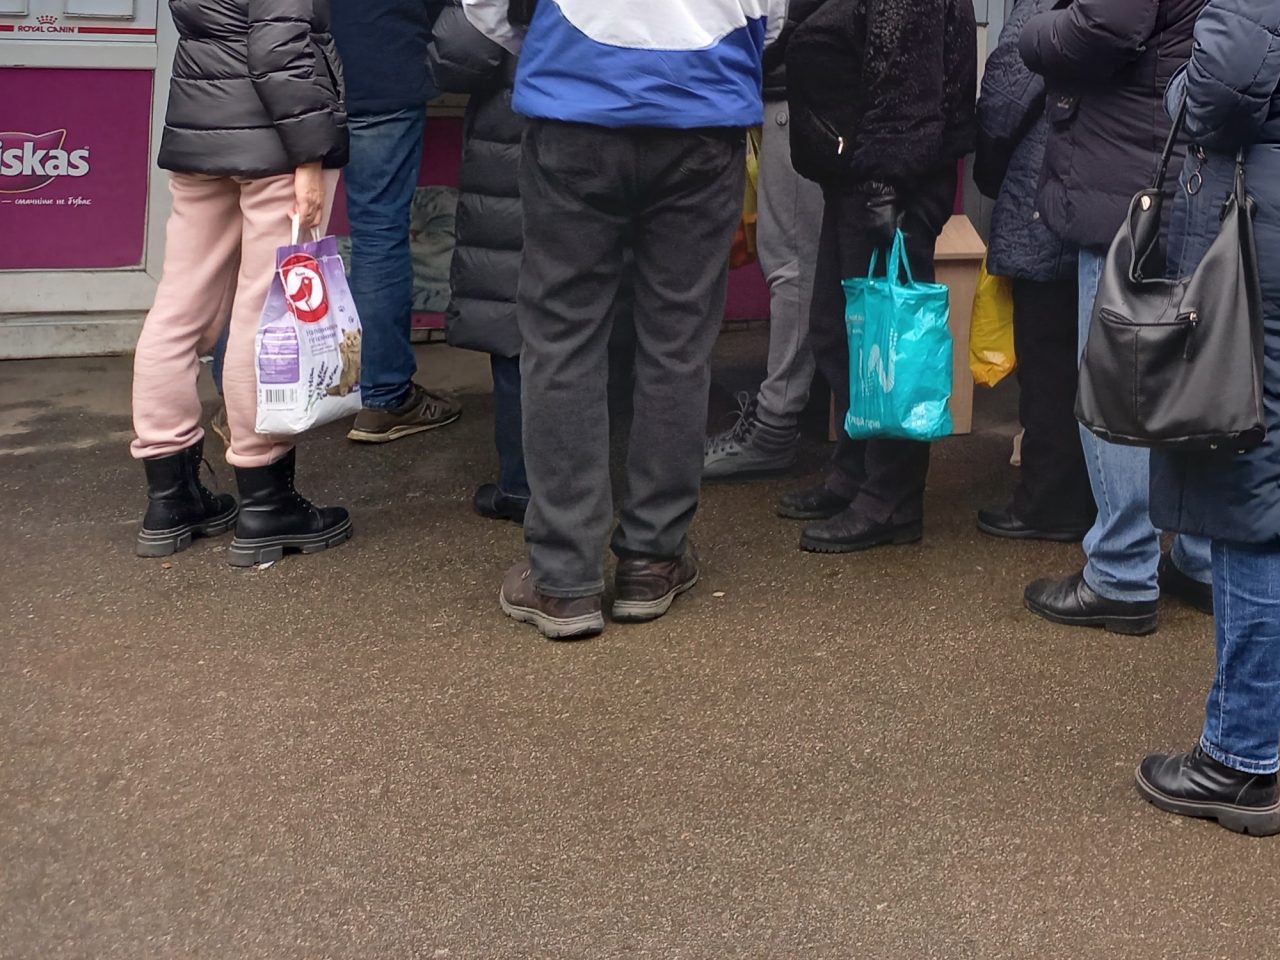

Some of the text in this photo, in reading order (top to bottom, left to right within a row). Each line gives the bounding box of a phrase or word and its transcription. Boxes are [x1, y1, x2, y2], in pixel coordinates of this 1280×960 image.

[18, 25, 75, 33] ROYAL CANIN
[0, 141, 90, 177] skas
